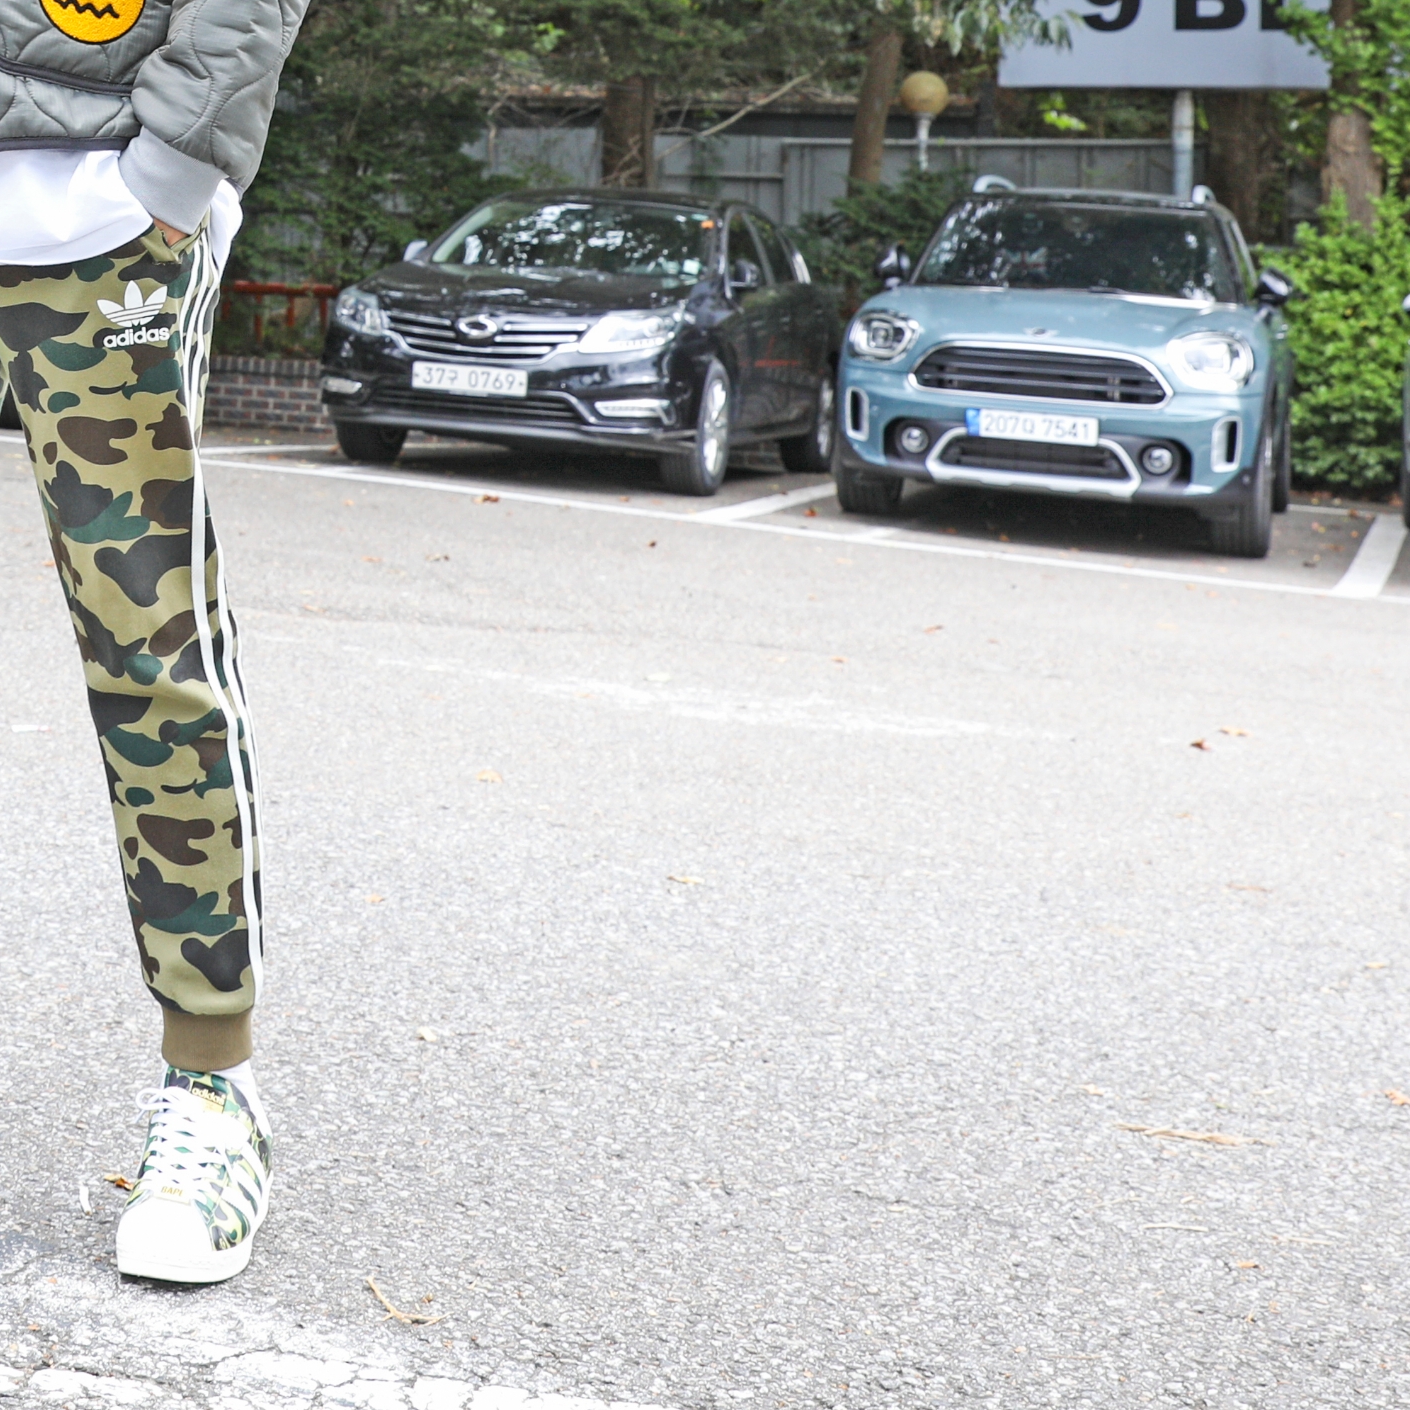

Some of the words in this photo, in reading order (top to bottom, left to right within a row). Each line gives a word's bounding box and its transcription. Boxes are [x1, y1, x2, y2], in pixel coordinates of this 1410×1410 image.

[103, 326, 170, 348] adidas
[468, 370, 517, 391] 0769
[1040, 418, 1090, 441] 7541
[191, 1087, 226, 1106] adidas
